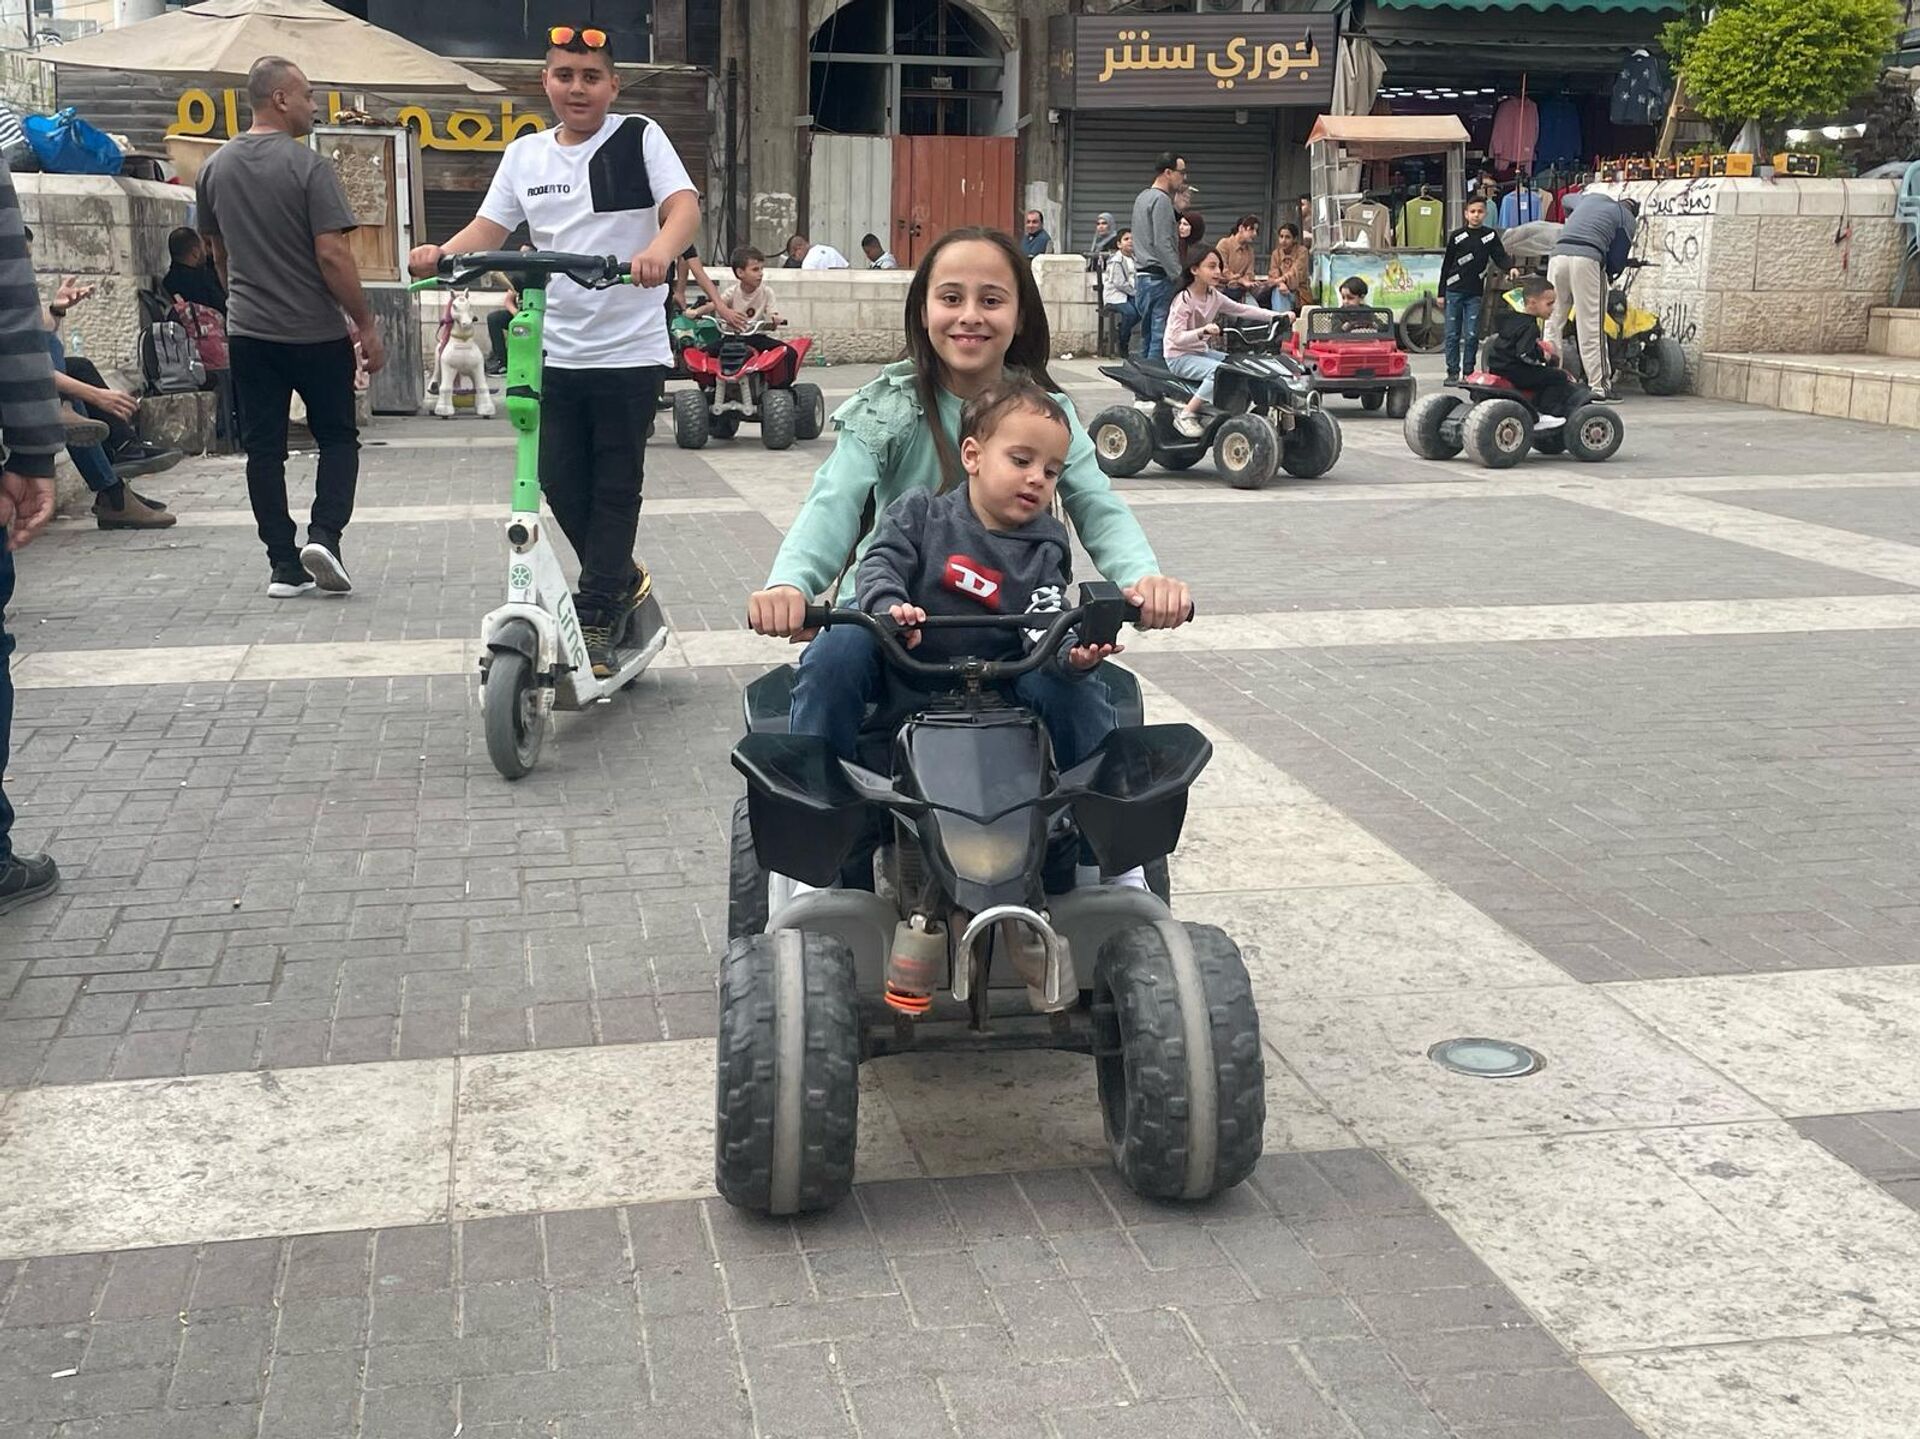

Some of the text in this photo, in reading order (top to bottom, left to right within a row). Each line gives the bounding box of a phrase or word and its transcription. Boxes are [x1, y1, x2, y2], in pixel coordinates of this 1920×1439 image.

[1098, 30, 1196, 82] سنتر
[1207, 37, 1320, 89] جوري
[557, 591, 584, 668] Lime
